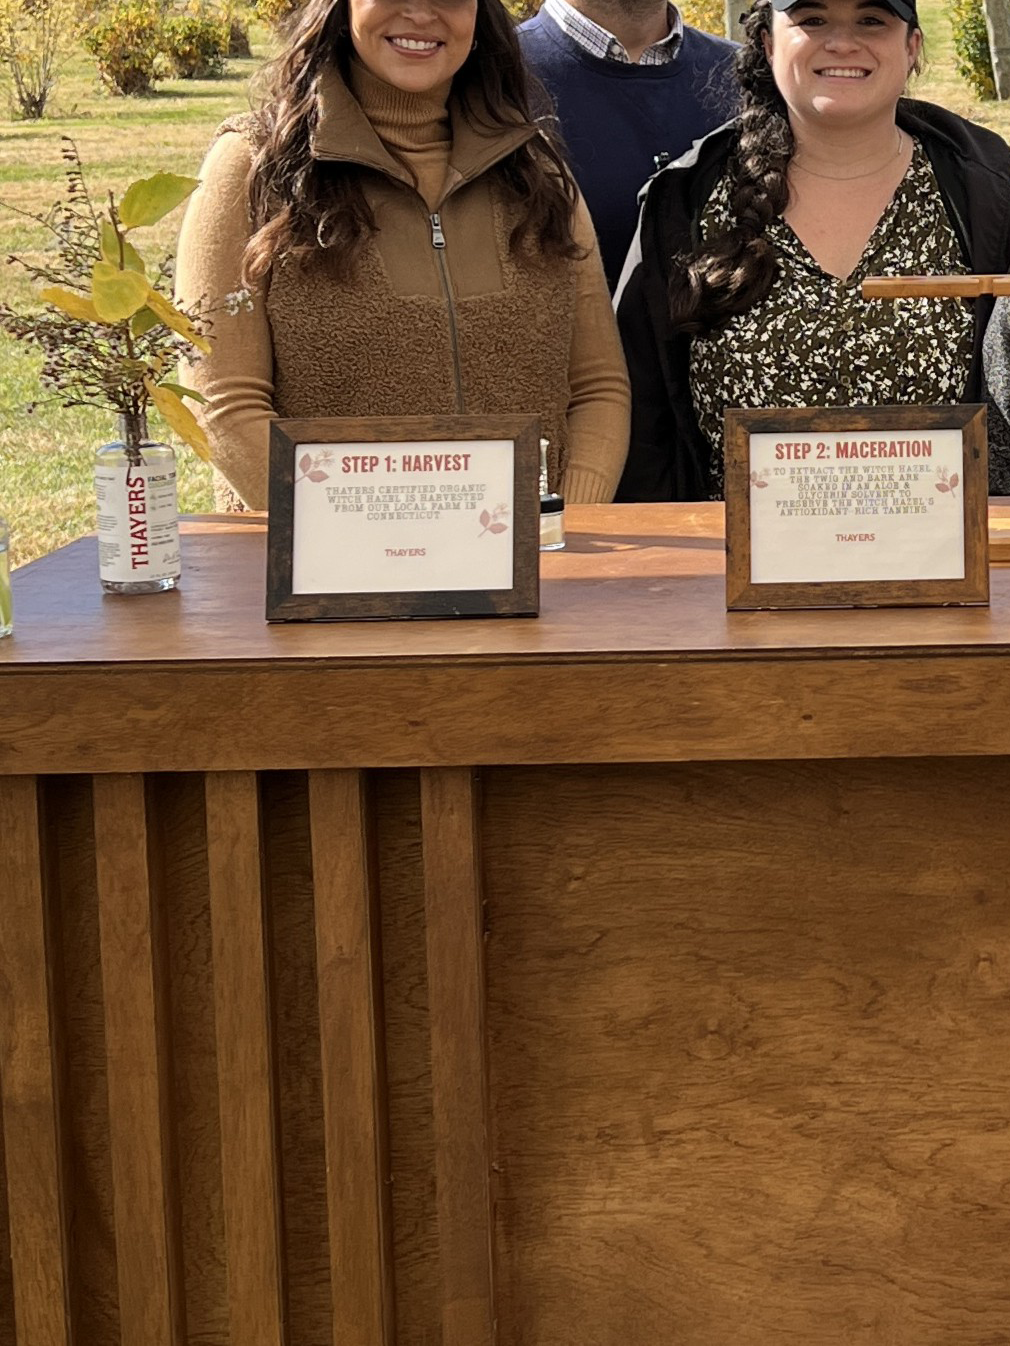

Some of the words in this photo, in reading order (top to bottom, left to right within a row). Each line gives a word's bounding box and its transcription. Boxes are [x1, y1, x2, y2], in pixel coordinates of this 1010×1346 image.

[775, 443, 811, 460] STEP
[816, 442, 830, 459] 2:
[836, 440, 932, 459] MACERATION
[342, 456, 379, 473] STEP
[384, 456, 396, 473] 1:
[402, 454, 471, 471] HARVEST
[774, 467, 785, 475] TO
[862, 465, 894, 473] WITCH
[326, 486, 375, 495] THAYERS
[379, 485, 436, 494] CERTIFIED
[440, 484, 486, 493] ORGANIC
[798, 491, 847, 499] GLYCERIN
[851, 490, 895, 498] SOLVENT
[367, 495, 401, 503] HAZEL
[420, 493, 484, 501] HARVESTED
[334, 504, 363, 512] FROM
[776, 500, 828, 508] PRESERVE
[127, 476, 148, 570] THAYERS
[835, 534, 875, 542] THAYERS
